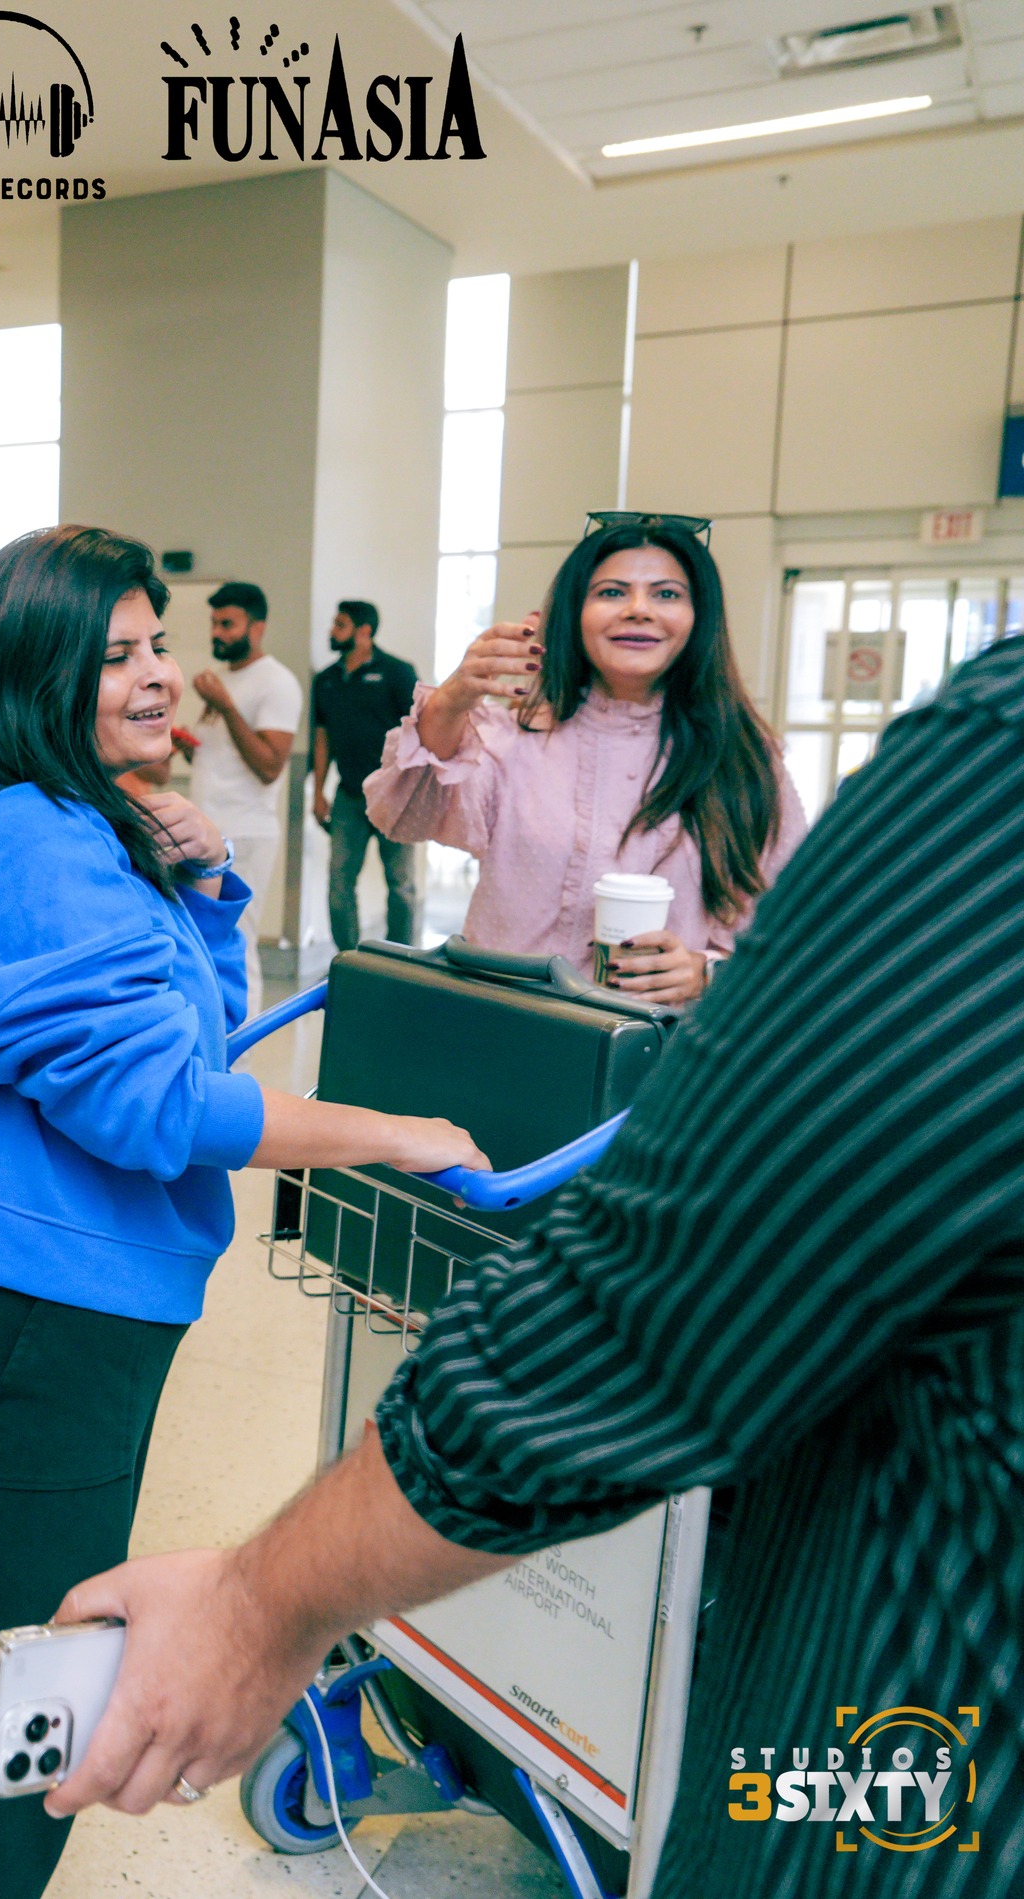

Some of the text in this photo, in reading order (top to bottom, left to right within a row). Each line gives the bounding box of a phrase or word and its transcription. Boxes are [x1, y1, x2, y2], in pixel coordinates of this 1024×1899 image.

[932, 511, 974, 539] EXIT
[504, 1573, 561, 1620] AIRPORT
[545, 1553, 597, 1600] WORTH
